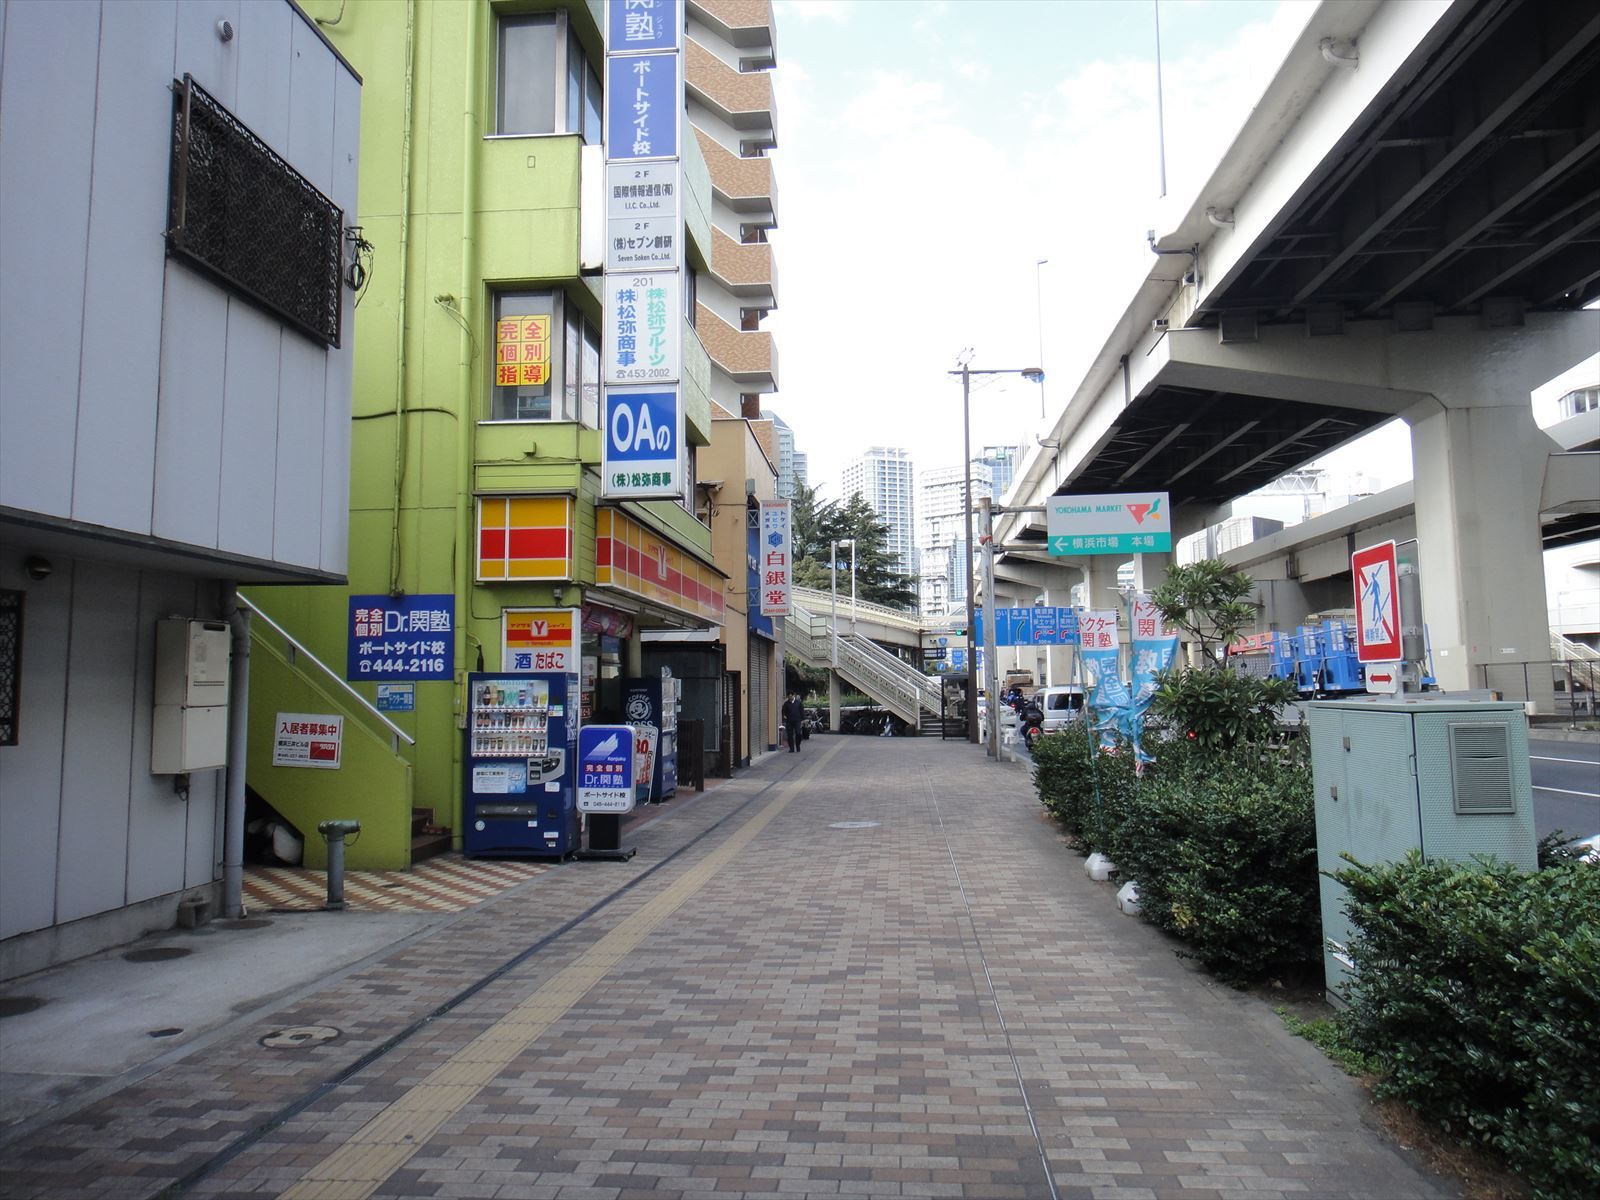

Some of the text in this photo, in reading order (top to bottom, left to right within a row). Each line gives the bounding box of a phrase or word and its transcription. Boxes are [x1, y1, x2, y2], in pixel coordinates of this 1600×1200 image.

[632, 60, 651, 155] ポートサイド校
[613, 235, 673, 250] (株)セブン創研
[618, 254, 634, 262] Seven
[632, 277, 653, 287] 201
[501, 322, 542, 340] 完全
[500, 343, 542, 362] 個別
[500, 365, 542, 383] 指導
[612, 472, 671, 487] (株)松弥商事
[1055, 504, 1122, 514] YOKOHAMA MARKET
[1072, 535, 1155, 549] 横浜市場 本場
[765, 551, 786, 605] 白銀堂
[355, 608, 383, 622] 完全
[385, 609, 451, 632] Dr.関塾
[355, 623, 383, 637] 個別
[1082, 632, 1112, 647] 関塾
[359, 641, 445, 655] ポートサイド校
[373, 659, 444, 672] 444-2116
[515, 652, 565, 669] 酒 たばこ
[280, 722, 337, 736] 入居者募集中
[584, 774, 623, 785] Dr.関塾
